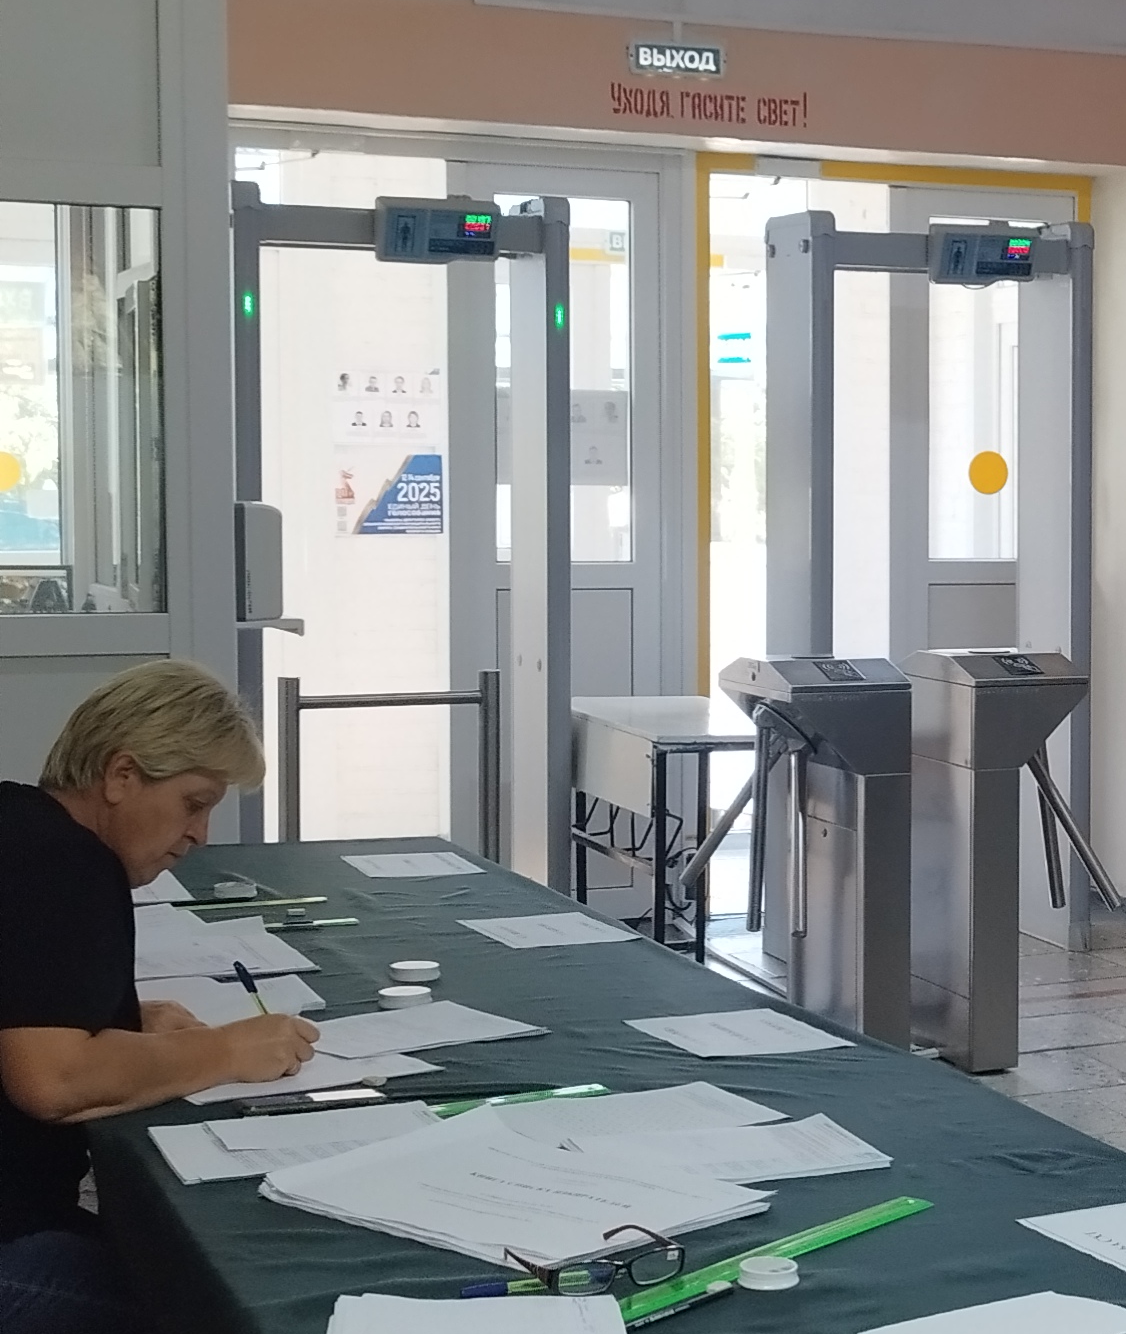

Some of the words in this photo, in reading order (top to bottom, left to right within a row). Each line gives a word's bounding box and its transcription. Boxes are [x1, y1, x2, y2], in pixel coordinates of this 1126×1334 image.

[638, 47, 717, 72] ВЫХОД
[679, 91, 747, 124] ГАСИТЕ
[756, 91, 809, 128] СВЕТ!
[396, 482, 441, 502] 2025
